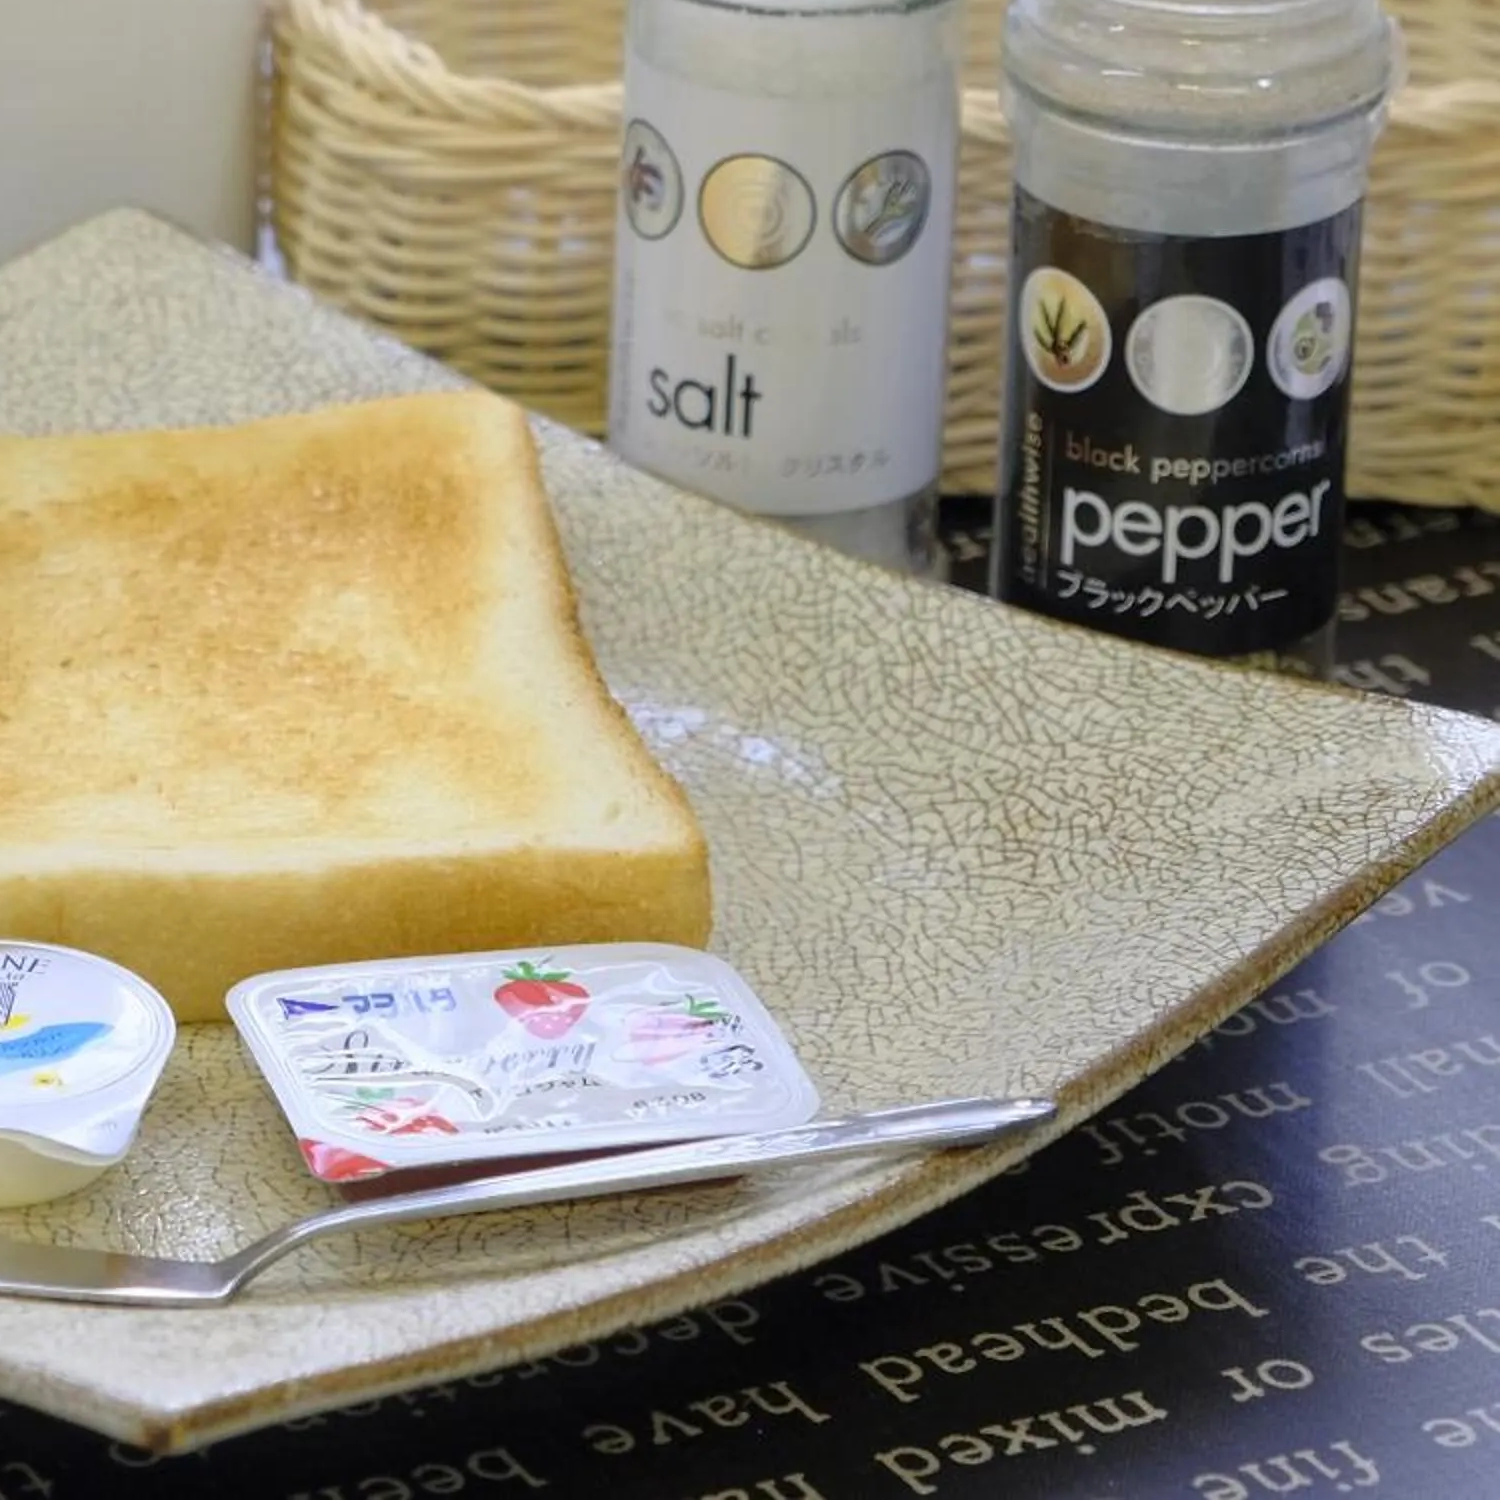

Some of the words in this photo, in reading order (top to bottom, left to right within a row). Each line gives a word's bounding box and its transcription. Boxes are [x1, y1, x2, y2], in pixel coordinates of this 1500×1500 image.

[645, 353, 763, 439] salt
[1064, 430, 1142, 474] black
[1059, 478, 1332, 585] pepper
[1384, 960, 1471, 1010] of
[1080, 1080, 1312, 1167] motif
[1292, 1235, 1449, 1286] the
[858, 1277, 1270, 1404] bedhead
[1359, 1307, 1500, 1364] les
[1219, 1358, 1315, 1403] or
[580, 1379, 833, 1455] have
[873, 1389, 1169, 1496] mixed
[1191, 1440, 1382, 1500] fine
